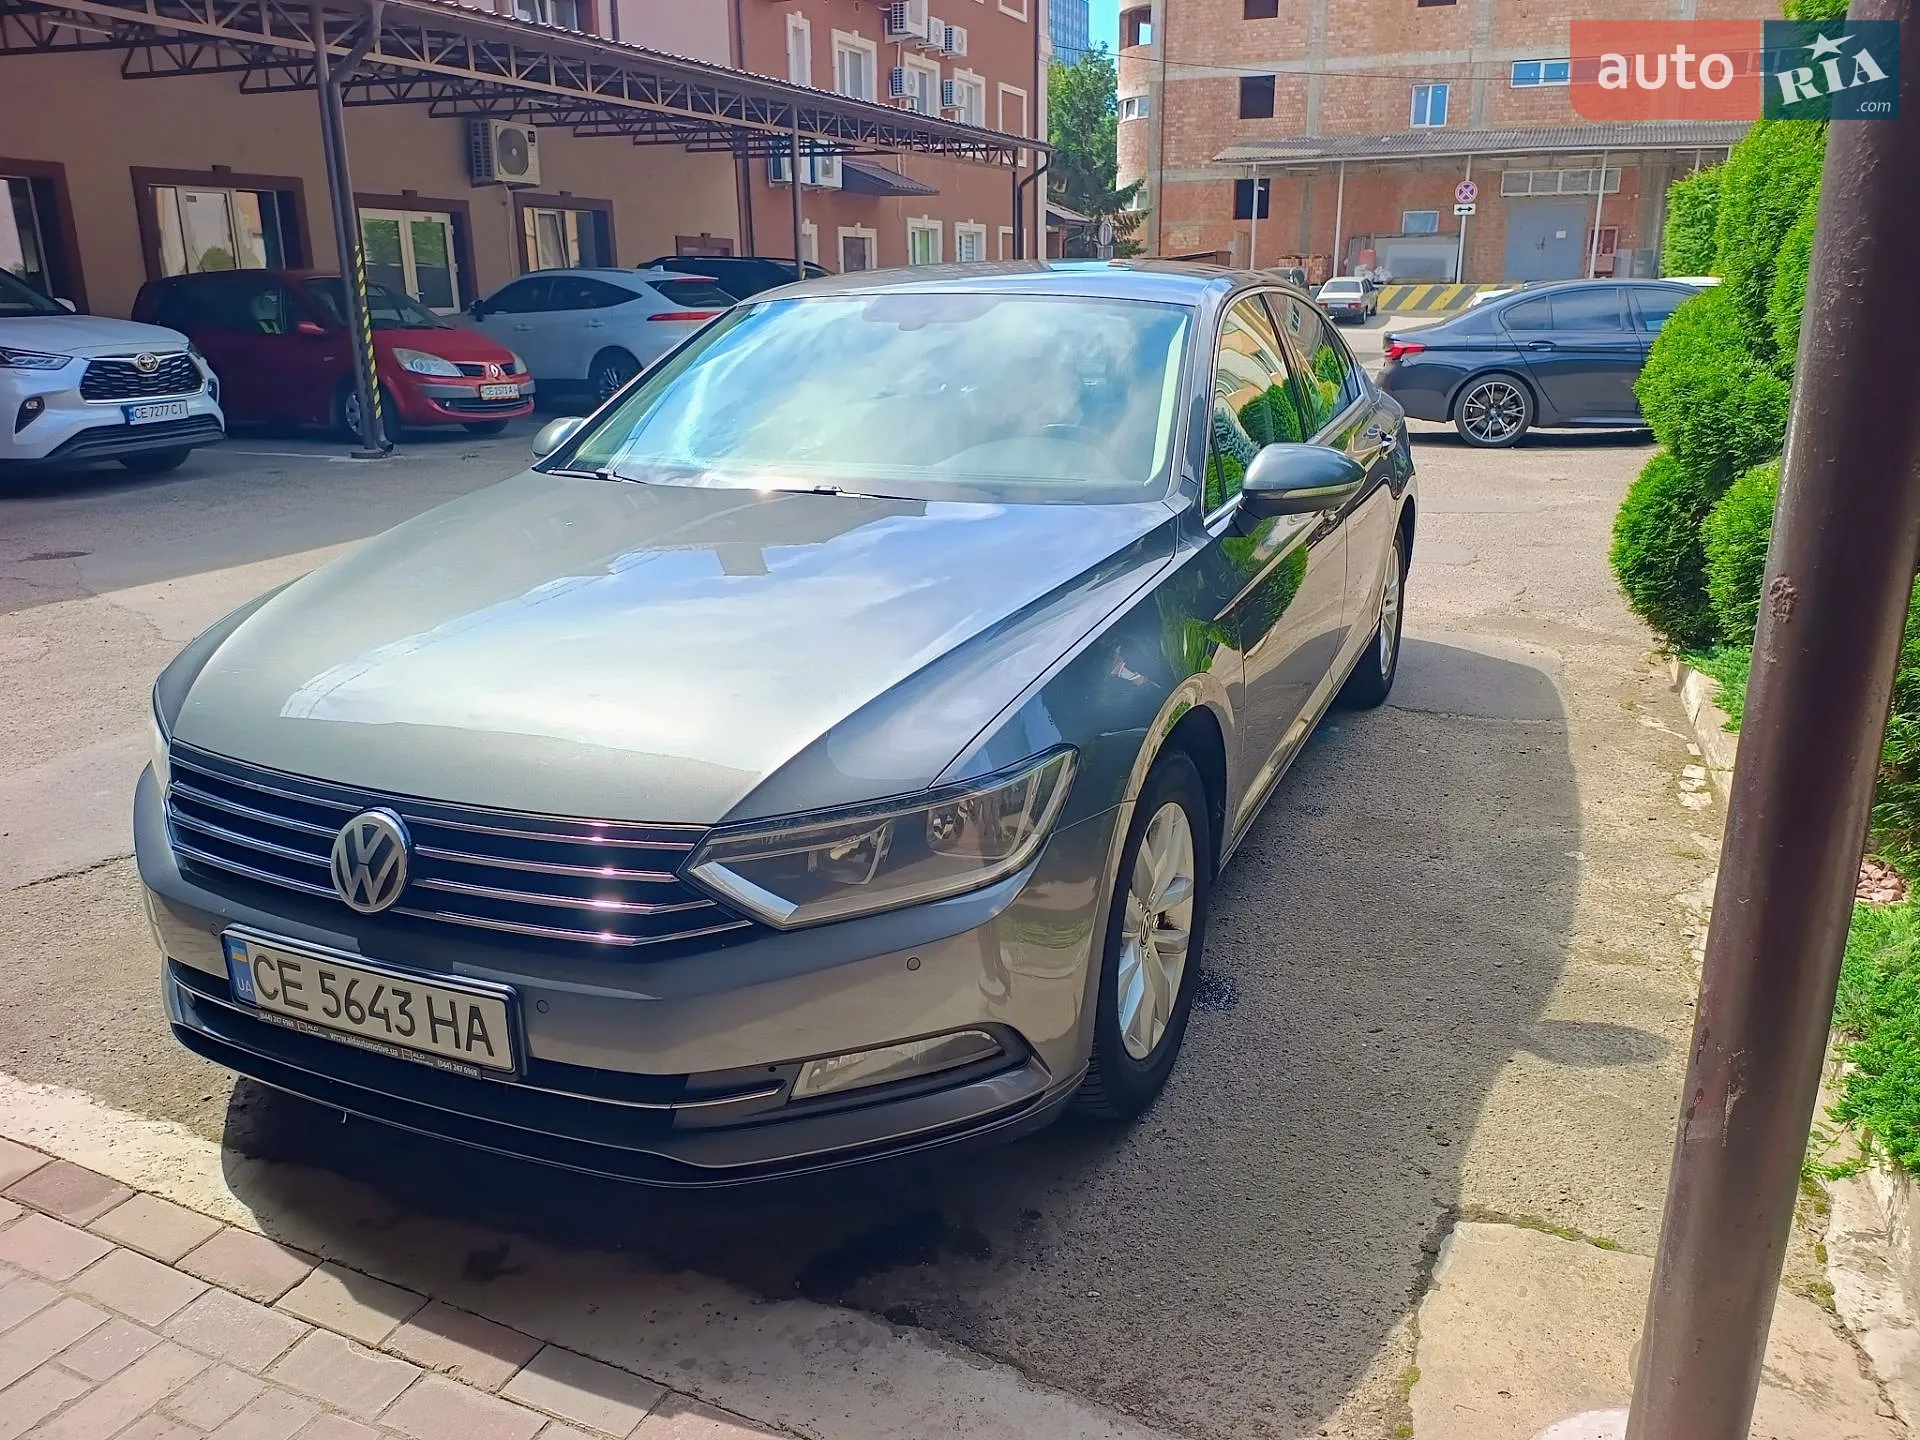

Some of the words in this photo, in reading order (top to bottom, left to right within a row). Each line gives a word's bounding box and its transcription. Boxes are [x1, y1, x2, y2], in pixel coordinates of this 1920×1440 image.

[135, 407, 148, 419] CE
[150, 404, 169, 418] 7277
[171, 403, 183, 415] CI
[237, 976, 253, 994] UA
[253, 955, 309, 1011] CE
[318, 970, 416, 1038] 5643
[426, 994, 495, 1057] HA
